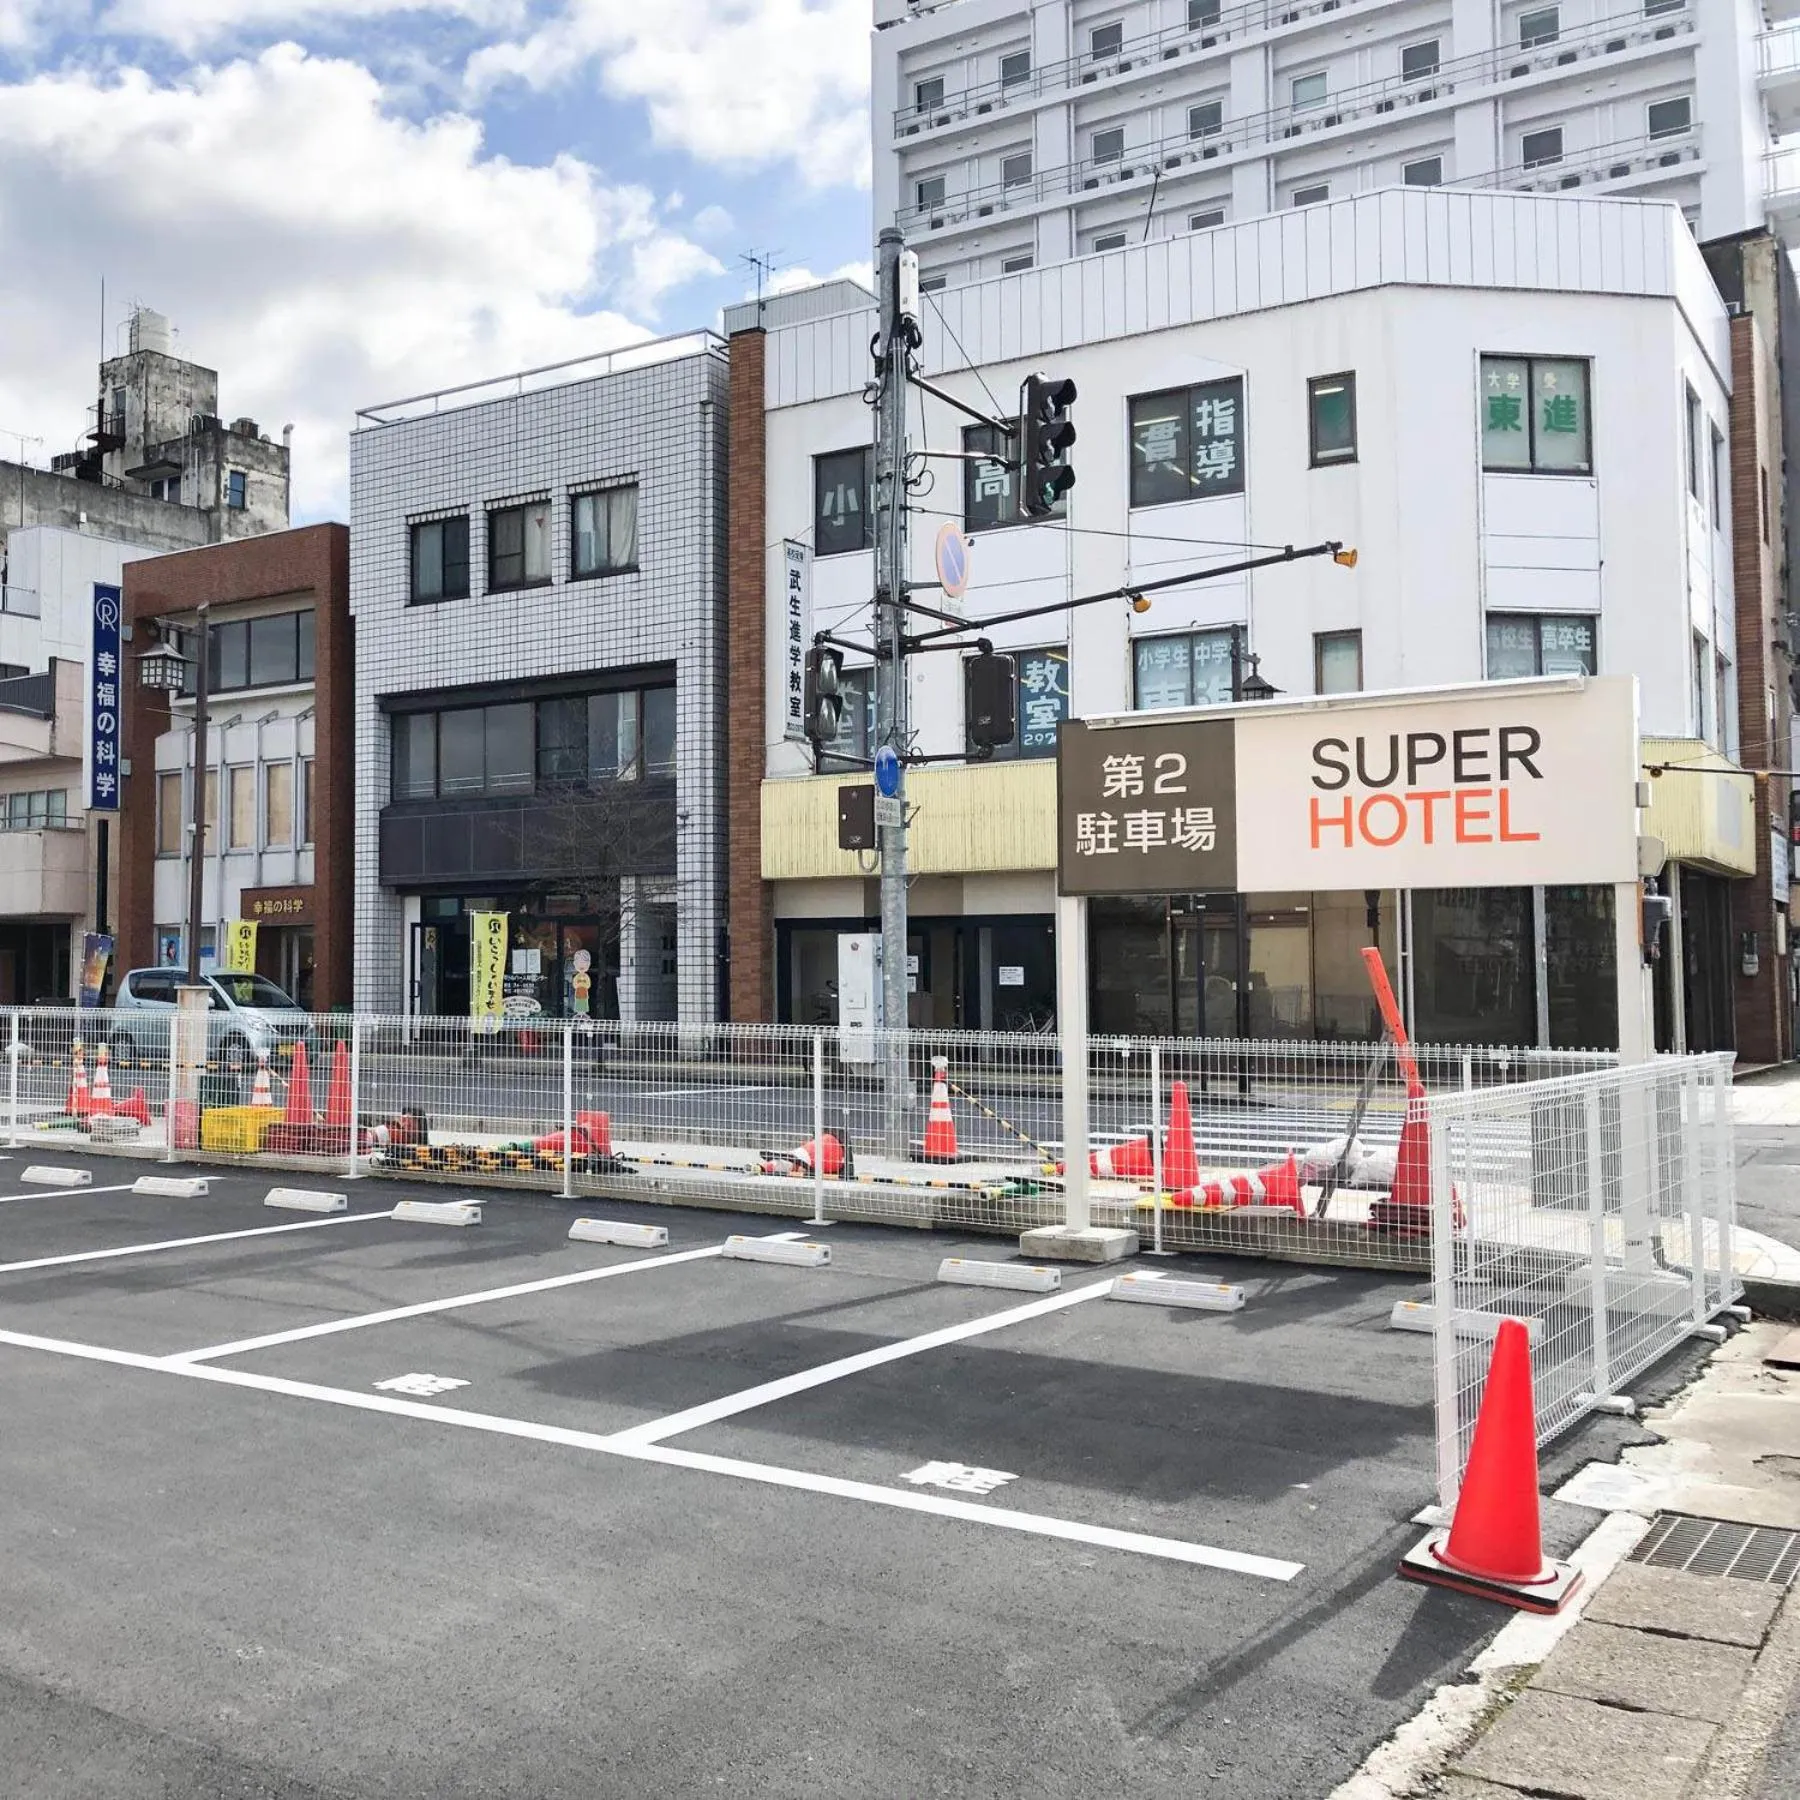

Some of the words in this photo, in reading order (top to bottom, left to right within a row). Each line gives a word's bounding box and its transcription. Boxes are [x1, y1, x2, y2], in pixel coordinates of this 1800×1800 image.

[1487, 393, 1577, 433] 東進
[1195, 398, 1236, 480] 指導
[822, 483, 859, 526] 小
[974, 457, 1011, 503] 高
[788, 569, 803, 718] 武生進学教室
[1137, 643, 1190, 672] 小学生
[1025, 659, 1062, 730] 教室
[96, 651, 116, 798] 幸福の科学
[1101, 752, 1188, 799] 第2
[1312, 725, 1544, 791] SUPER
[1075, 806, 1217, 856] 駐車場
[1309, 788, 1540, 849] HOTEL
[253, 899, 303, 915] 幸福の科学
